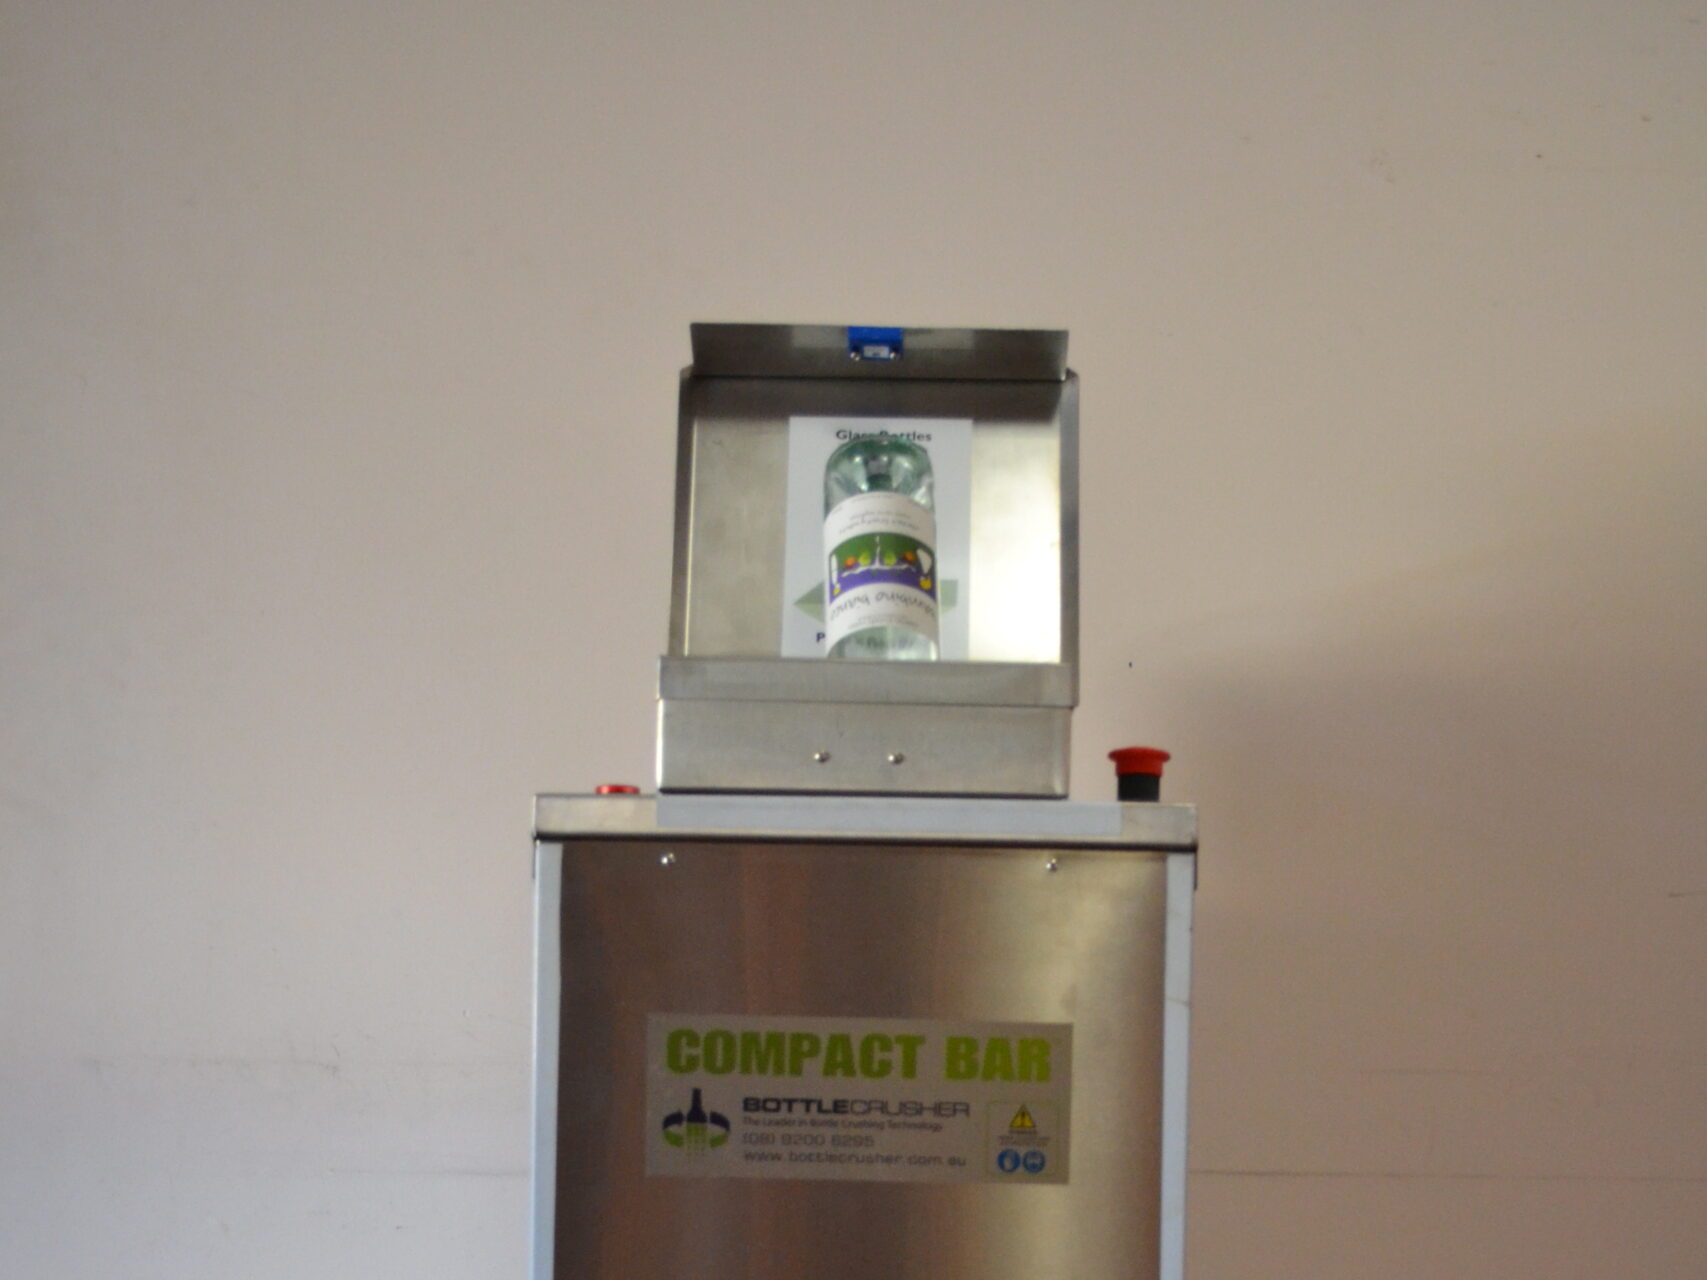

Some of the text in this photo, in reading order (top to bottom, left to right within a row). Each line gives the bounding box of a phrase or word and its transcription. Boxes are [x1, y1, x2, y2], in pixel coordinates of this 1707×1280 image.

[666, 1028, 1052, 1082] COMPACT BAR
[742, 1097, 971, 1117] BOTTLECRUSHER
